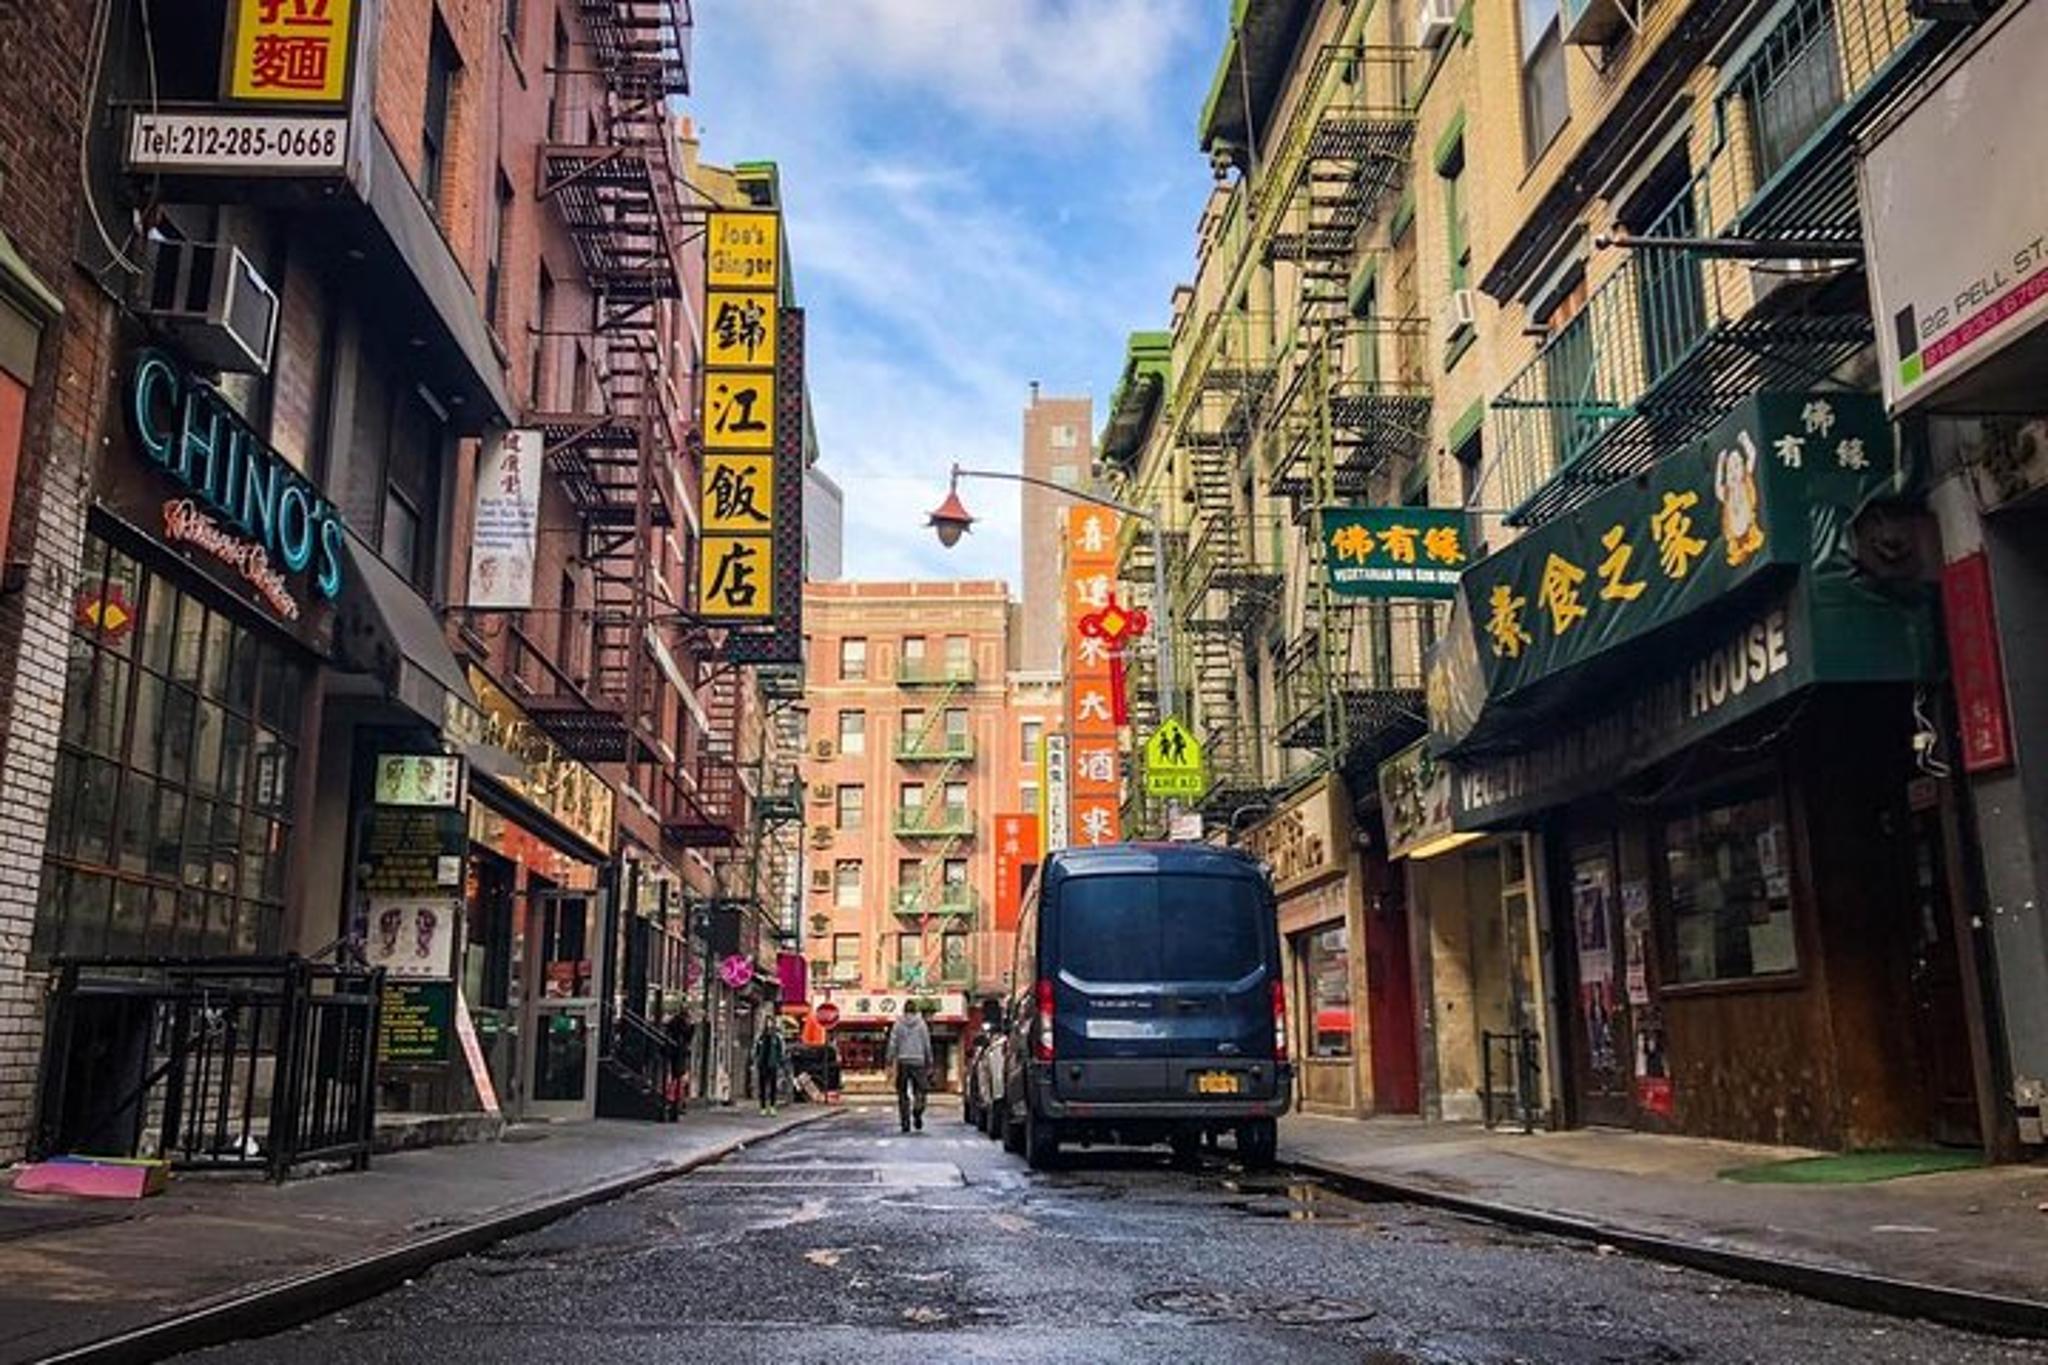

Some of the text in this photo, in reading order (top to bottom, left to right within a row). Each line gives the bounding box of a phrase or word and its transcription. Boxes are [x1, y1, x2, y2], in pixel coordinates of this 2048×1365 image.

[711, 248, 772, 280] Ginger
[1919, 305, 1951, 340] 22
[1954, 271, 2009, 314] PELL
[134, 350, 345, 600] CHINO'S
[705, 298, 769, 608] 錦江飯店
[1486, 490, 1708, 660] 素食之家
[1691, 611, 1789, 718] HOUSE
